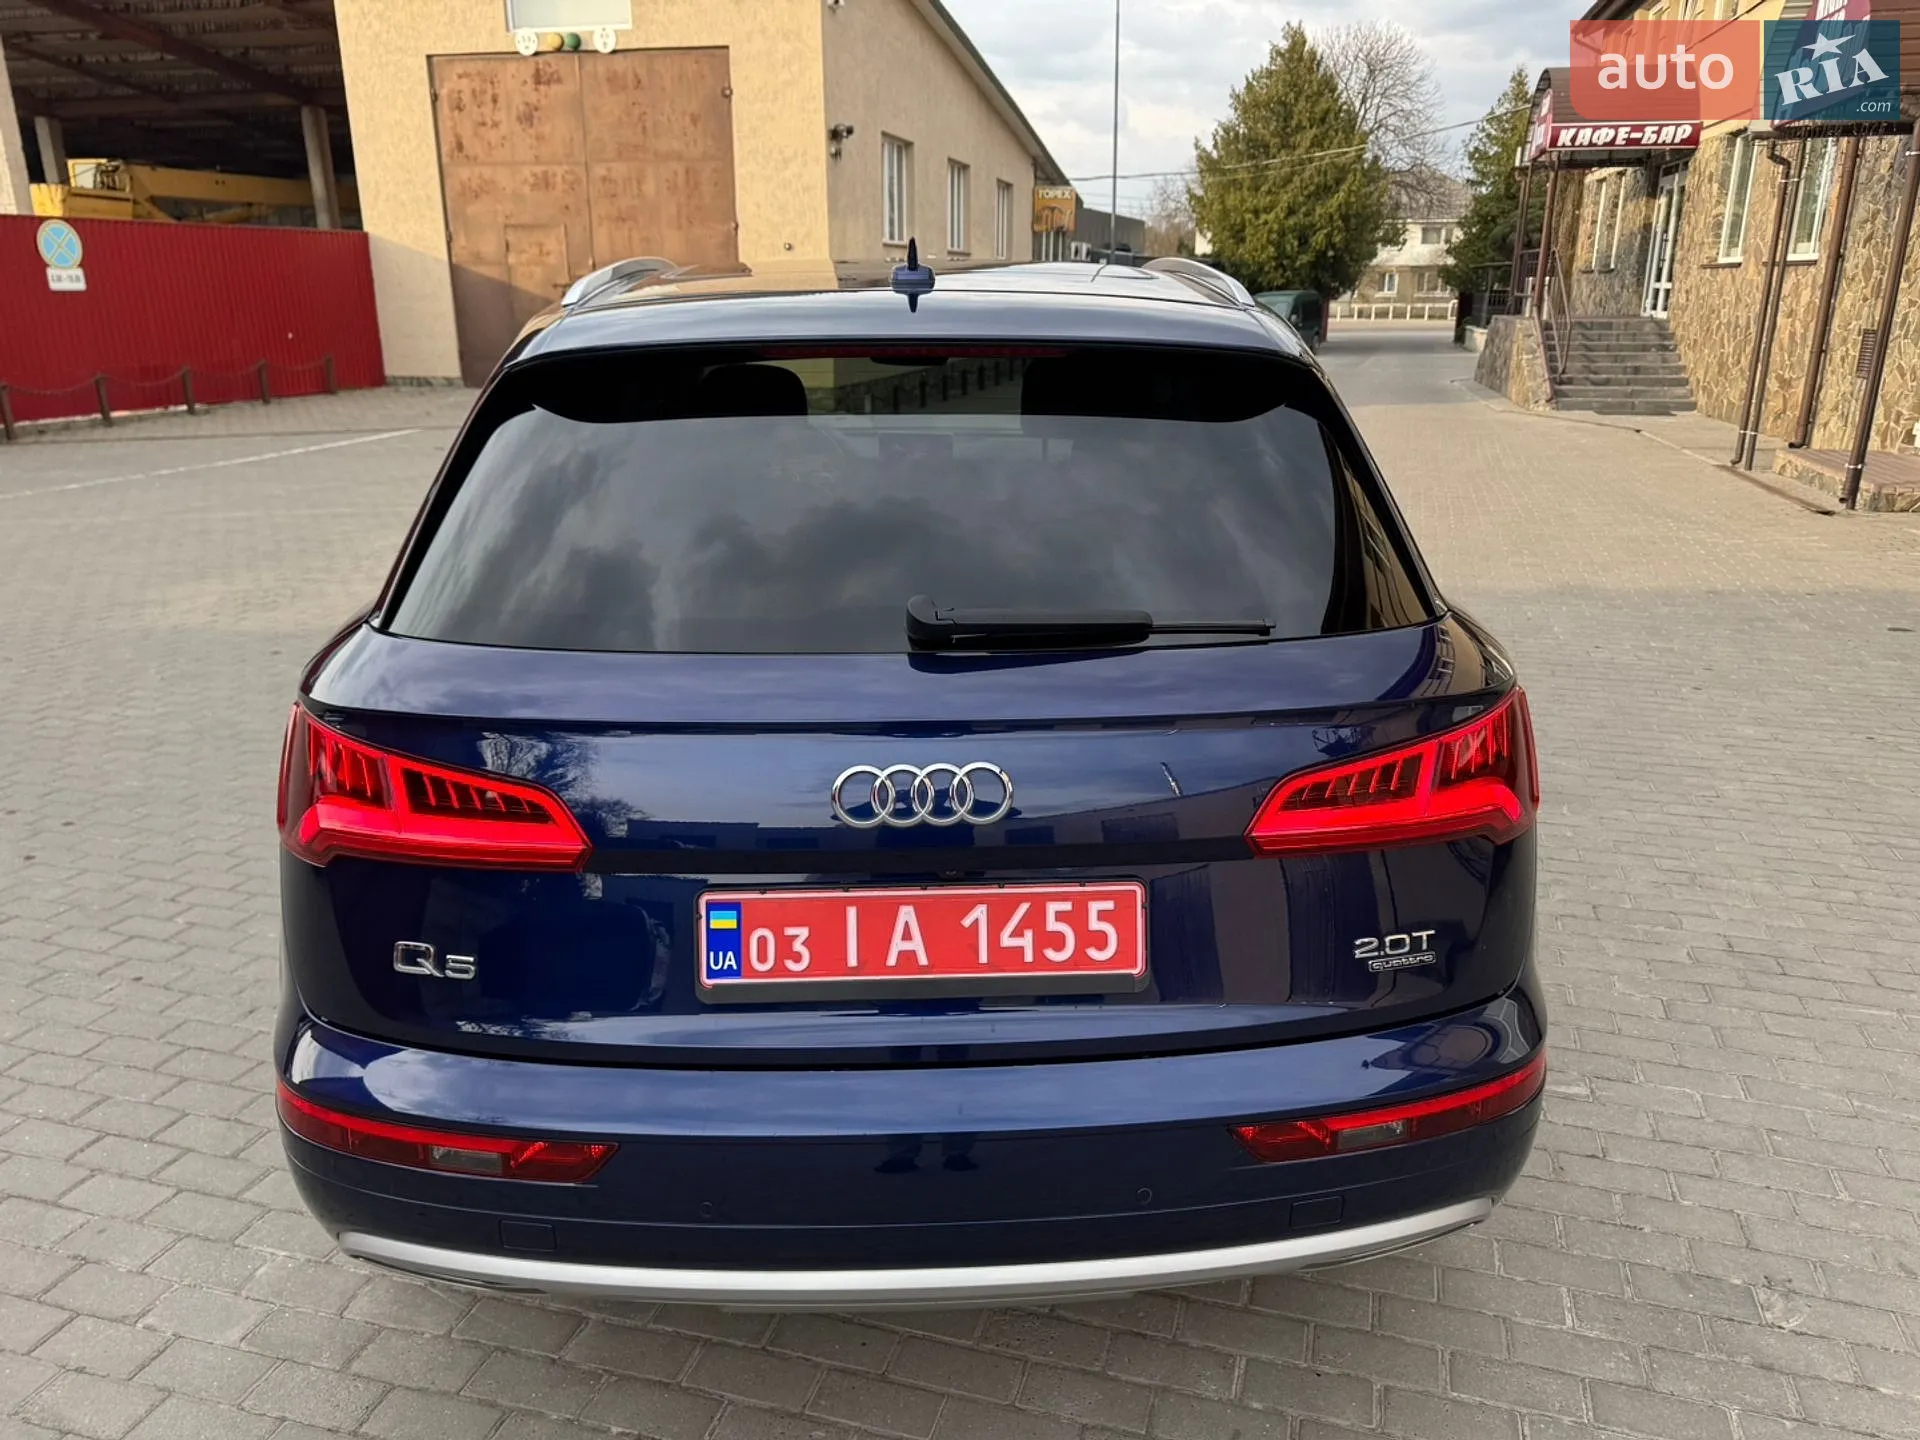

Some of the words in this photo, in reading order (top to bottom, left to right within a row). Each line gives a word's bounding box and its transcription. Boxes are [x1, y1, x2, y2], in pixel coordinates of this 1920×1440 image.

[1557, 124, 1692, 147] КАФЕ-БАР
[749, 926, 812, 972] 03
[845, 904, 929, 968] IA
[960, 901, 1119, 964] 1455
[1354, 929, 1436, 959] 2.0T
[393, 940, 476, 980] Q5
[709, 950, 738, 971] UA
[1370, 953, 1434, 972] quattro
